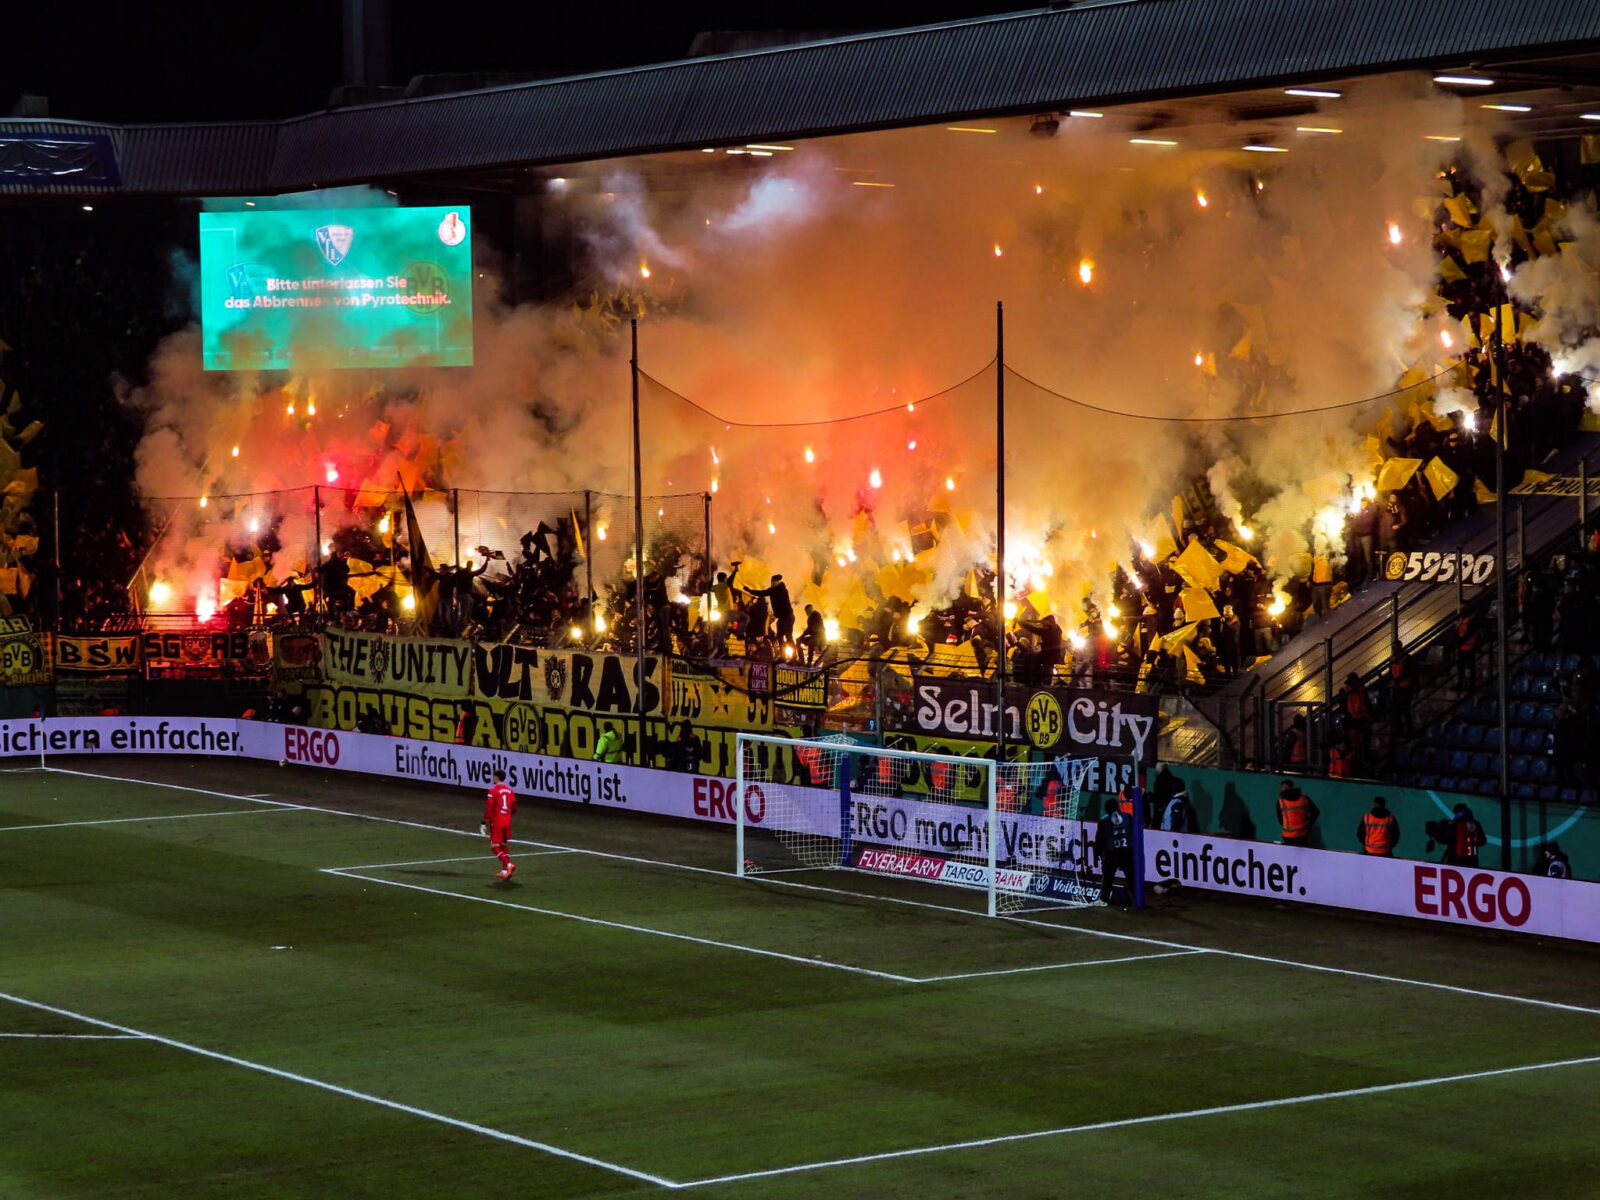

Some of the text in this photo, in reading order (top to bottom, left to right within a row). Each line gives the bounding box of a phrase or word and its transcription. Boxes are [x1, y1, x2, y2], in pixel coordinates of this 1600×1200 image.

[225, 292, 451, 309] das Abbrenne von Pyrotechnik.
[267, 276, 408, 291] Bitte unterlassen Sie
[1402, 551, 1495, 584] 59590
[4, 645, 31, 668] BVB
[60, 640, 136, 665] BSW
[327, 632, 469, 686] THE UNITY
[476, 644, 660, 714] ULT RAS
[508, 706, 537, 744] BVB
[1030, 699, 1059, 734] BVB
[1067, 696, 1154, 762] City
[0, 721, 242, 752] ichern einfacher.
[284, 727, 340, 765] ERGO
[1039, 733, 1050, 744] 09
[395, 745, 627, 803] Einfach, weil's wichtig ist.
[502, 795, 507, 809] 1
[693, 778, 765, 824] ERGO
[859, 850, 943, 877] FLYERALARM
[1155, 839, 1307, 896] einfacher.
[1414, 865, 1532, 928] ERGO
